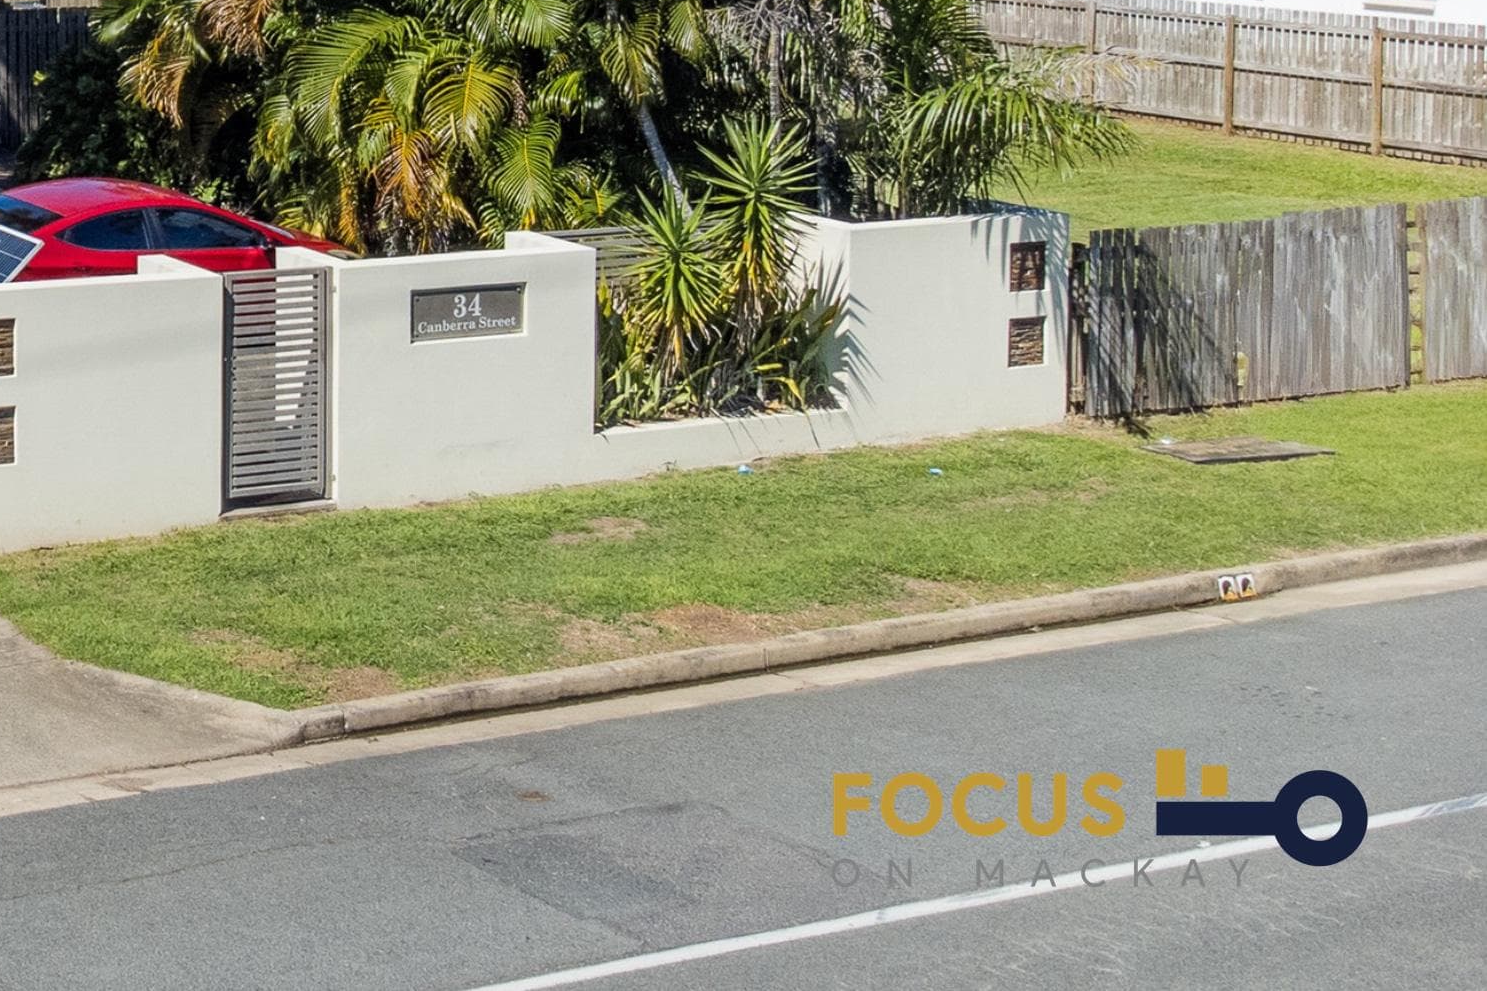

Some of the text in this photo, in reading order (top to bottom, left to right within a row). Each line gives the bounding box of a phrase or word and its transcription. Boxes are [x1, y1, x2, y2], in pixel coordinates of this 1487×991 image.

[453, 293, 482, 318] 34
[418, 316, 516, 333] Canberra Street
